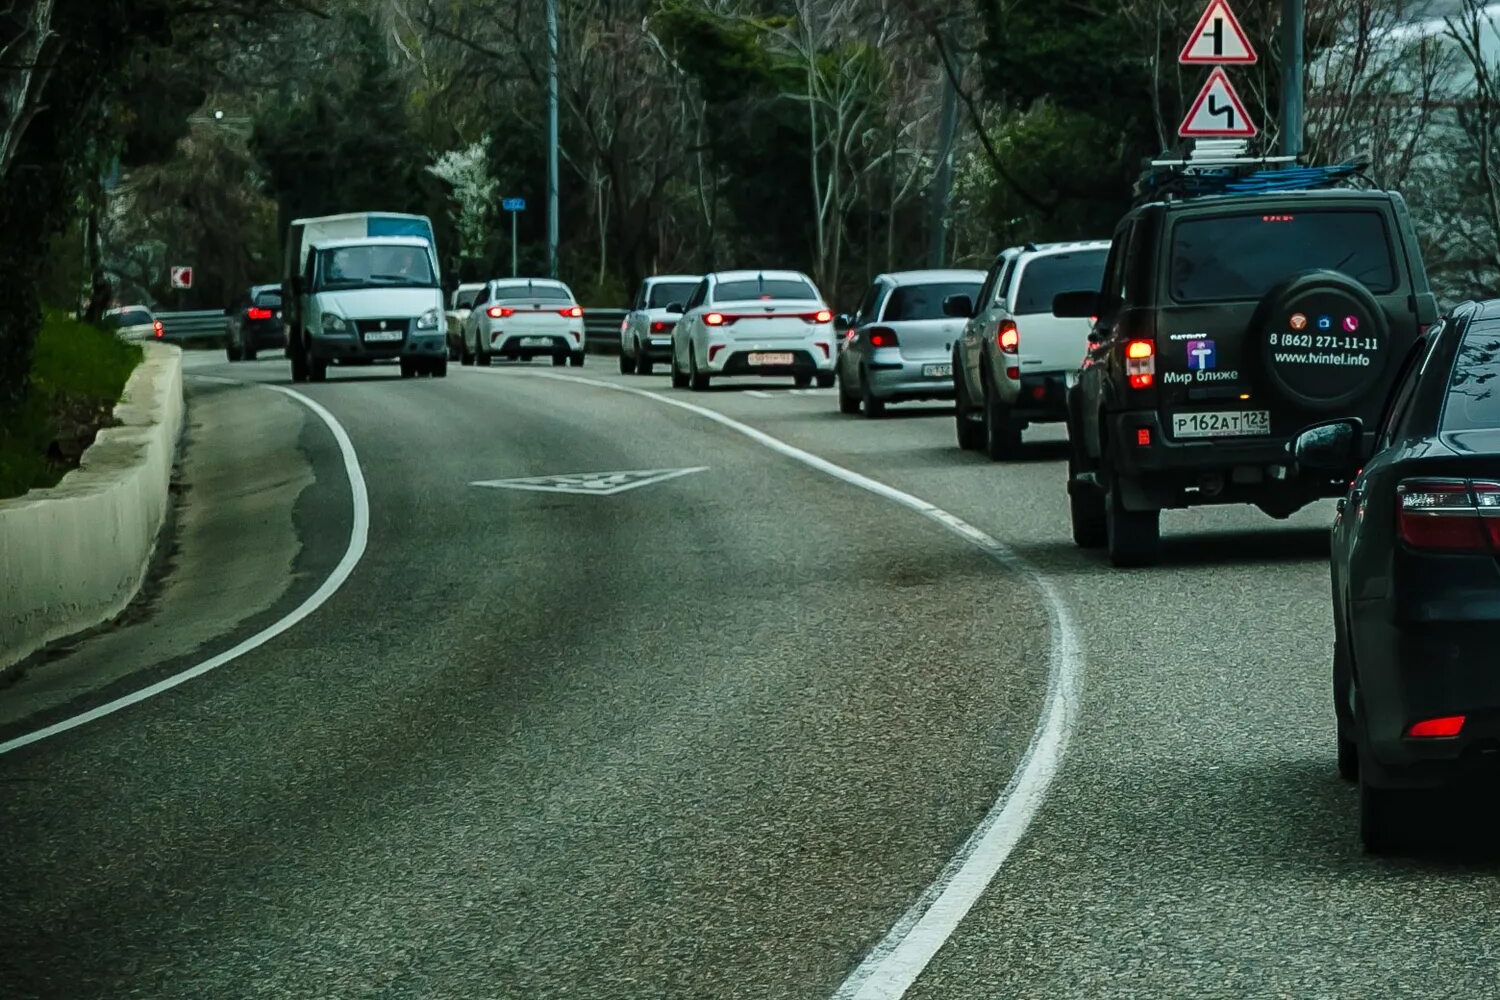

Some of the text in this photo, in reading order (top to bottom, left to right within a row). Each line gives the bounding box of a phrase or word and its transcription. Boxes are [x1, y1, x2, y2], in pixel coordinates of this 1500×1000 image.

[1269, 333, 1378, 350] 8 (862) 271-11-11
[1274, 352, 1370, 366] www.tvintel.info
[1163, 369, 1239, 385] Мир ближе
